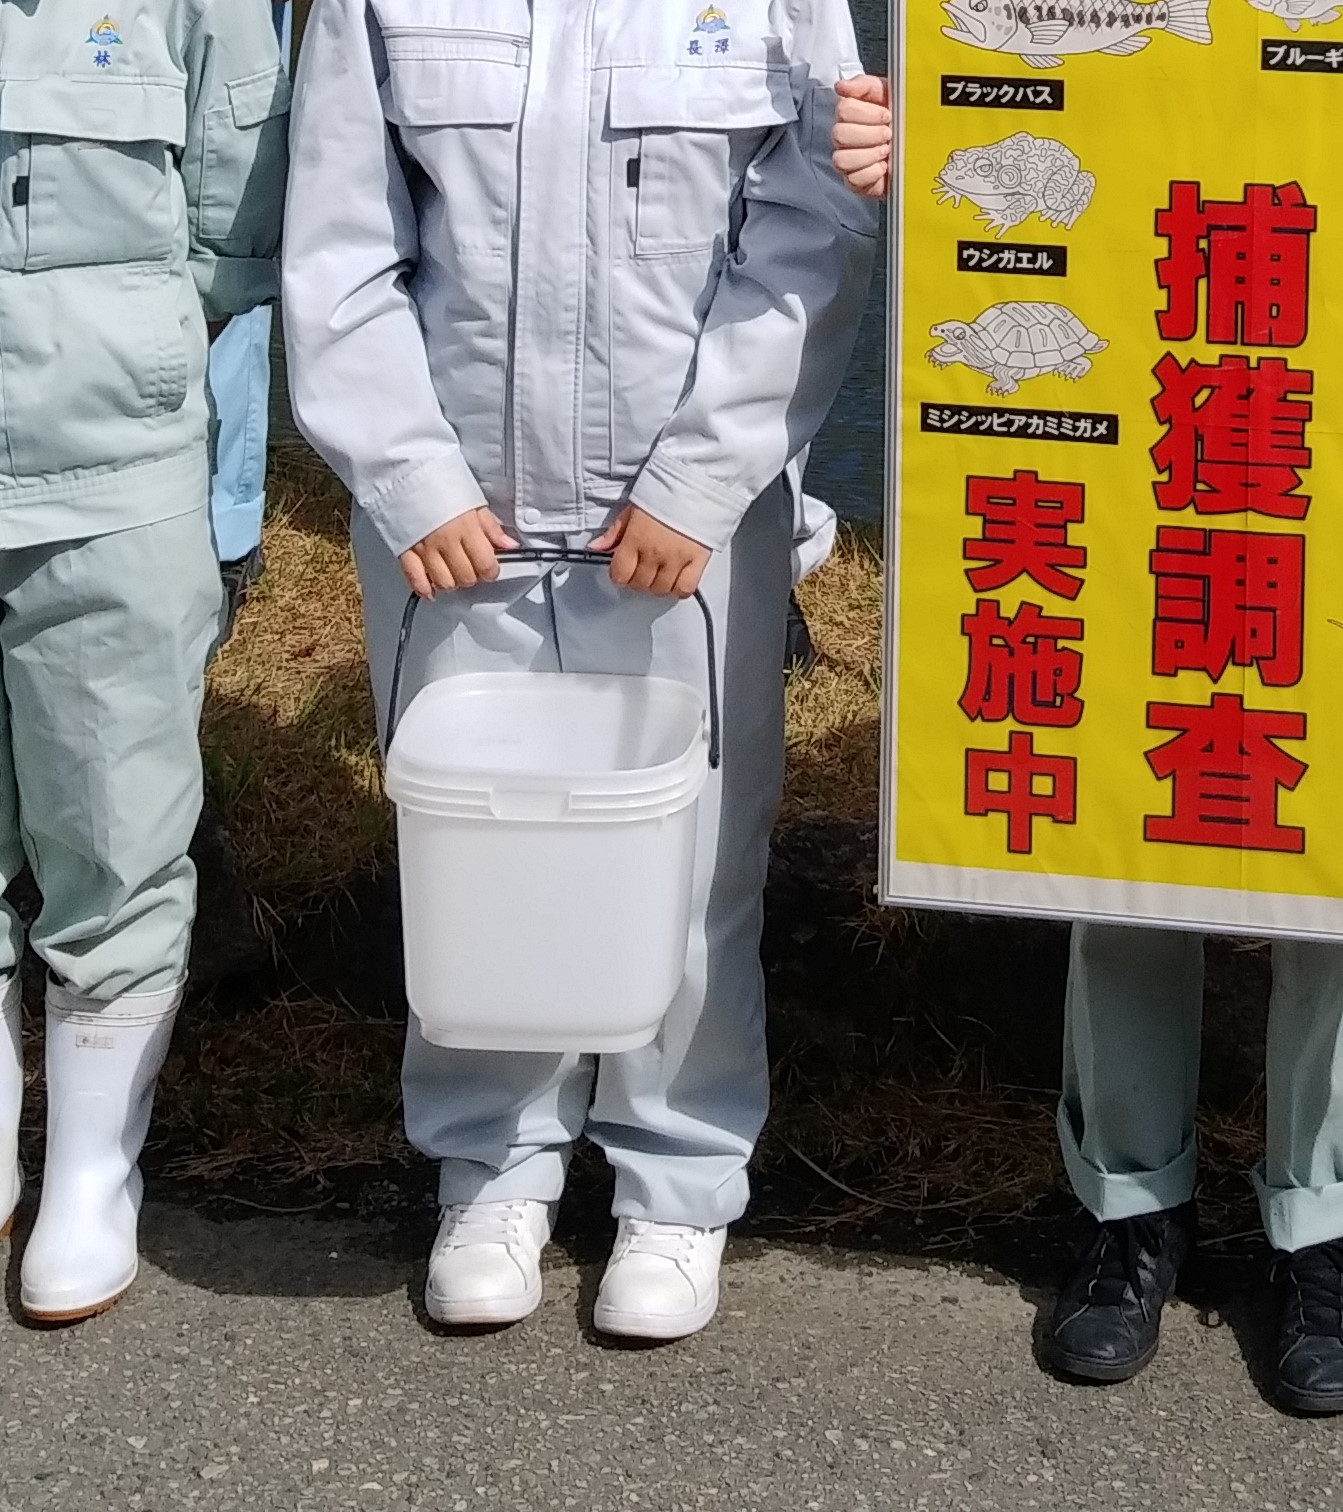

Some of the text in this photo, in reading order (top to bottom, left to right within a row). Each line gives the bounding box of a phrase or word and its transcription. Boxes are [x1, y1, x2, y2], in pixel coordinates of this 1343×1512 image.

[92, 49, 112, 69] 林
[946, 80, 1053, 104] ブラックバス
[962, 247, 1054, 270] ウシガエル
[926, 408, 1109, 438] ミシシッピアカミミガメ
[1143, 180, 1317, 854] 捕獲調査
[959, 469, 1087, 854] 実施中
